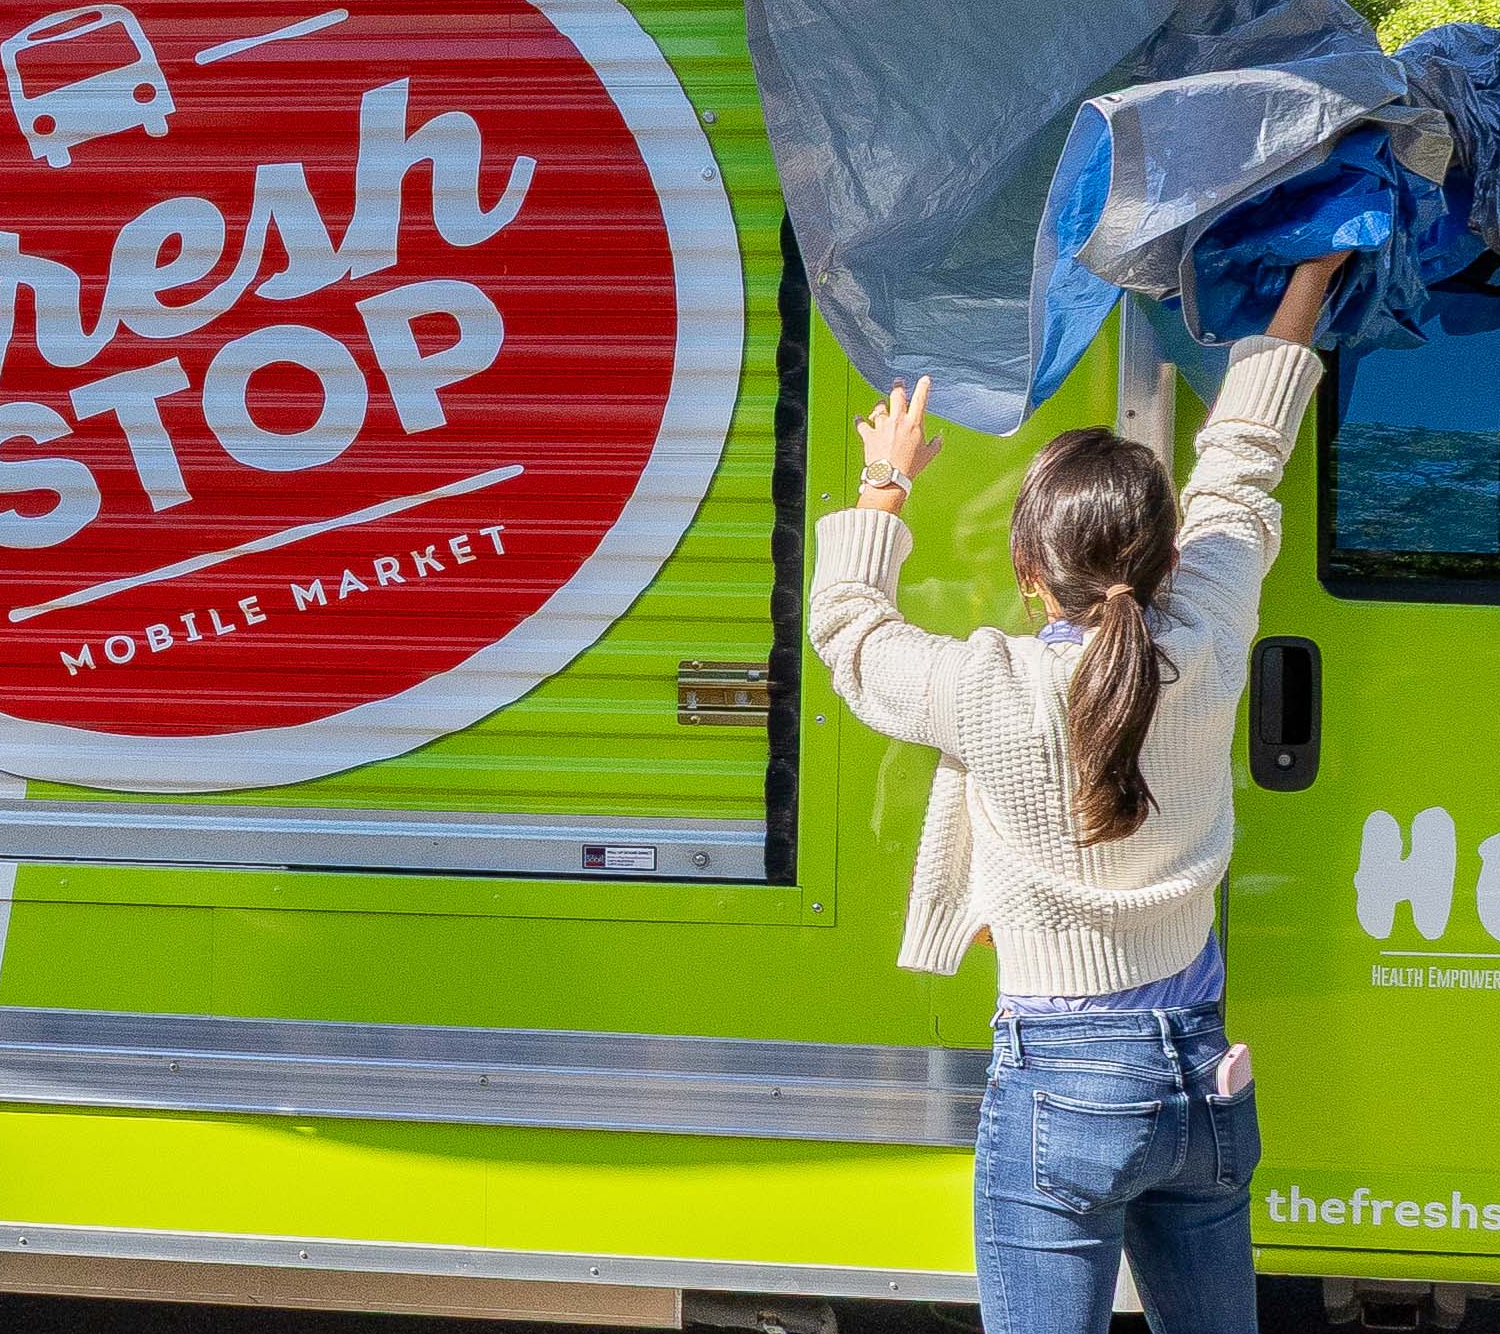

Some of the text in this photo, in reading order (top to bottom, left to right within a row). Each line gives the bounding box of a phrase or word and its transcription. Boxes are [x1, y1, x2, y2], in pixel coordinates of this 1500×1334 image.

[59, 523, 512, 677] MOBILE MARKET
[1371, 965, 1423, 988] HEALTH
